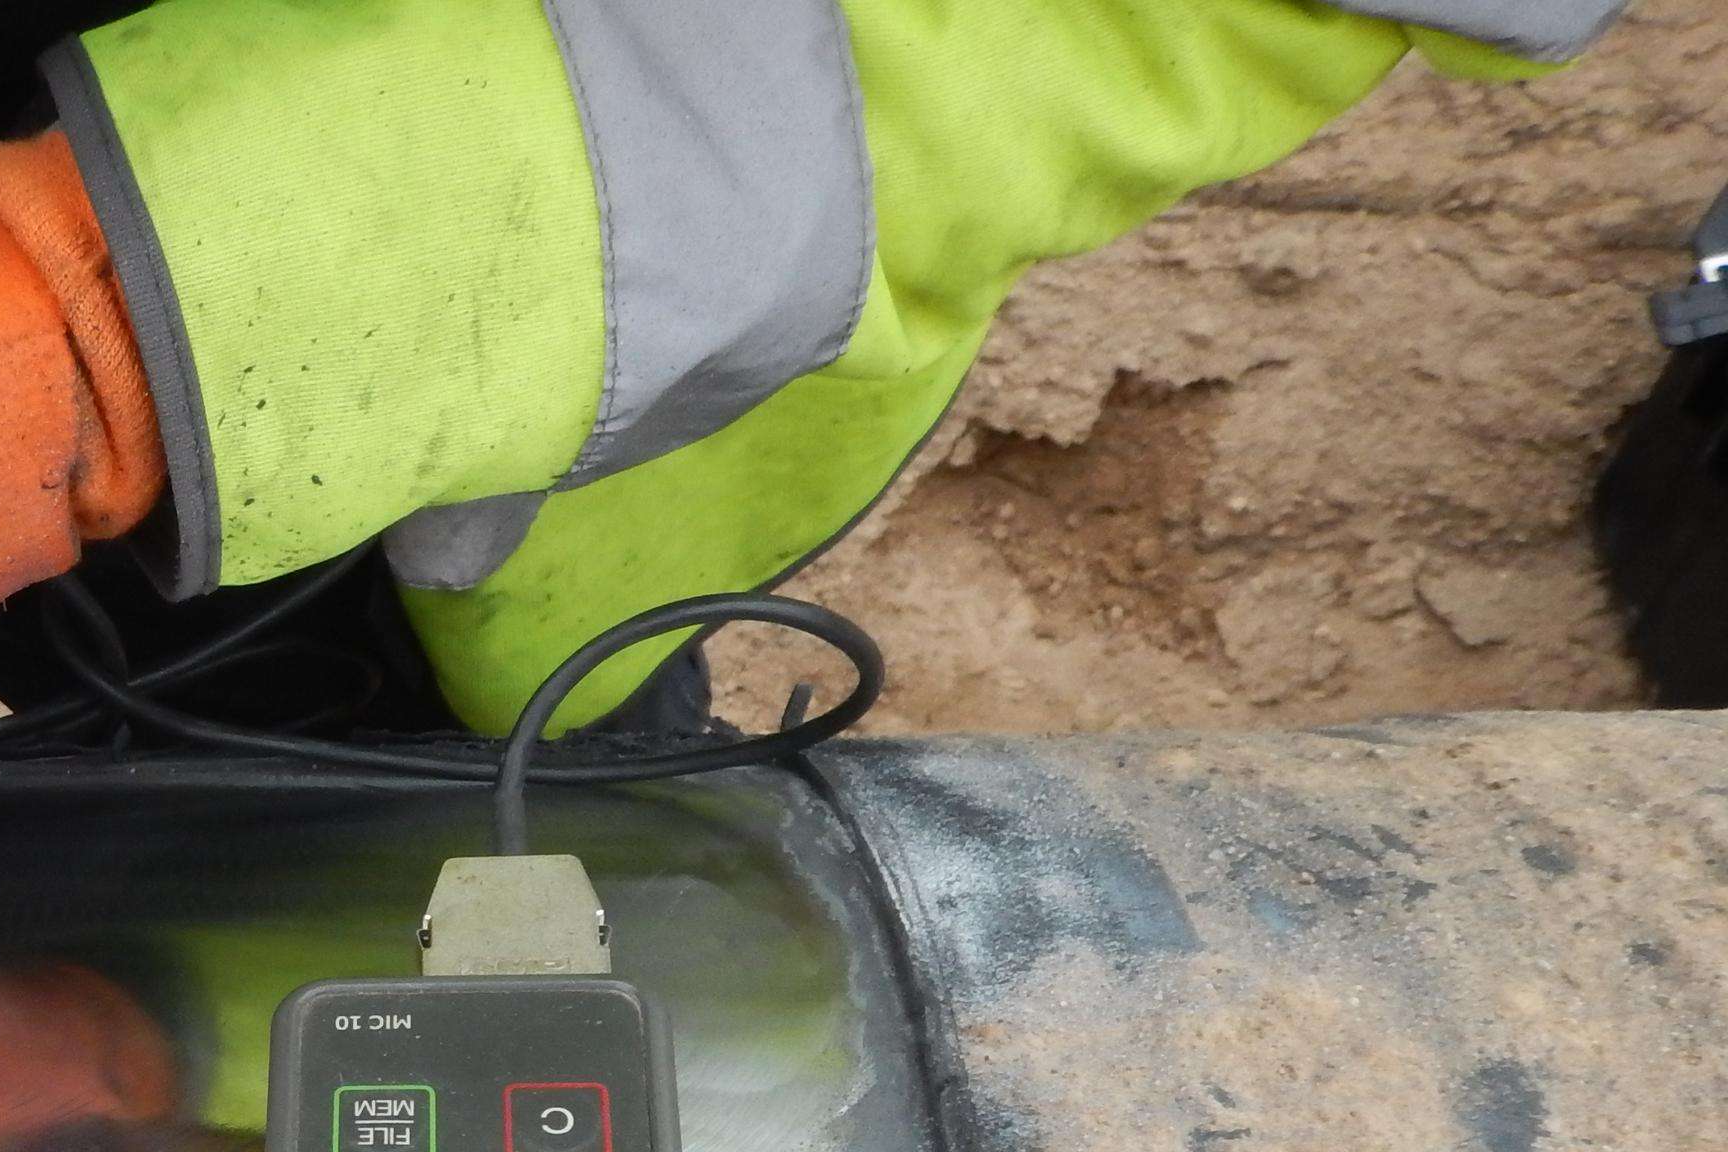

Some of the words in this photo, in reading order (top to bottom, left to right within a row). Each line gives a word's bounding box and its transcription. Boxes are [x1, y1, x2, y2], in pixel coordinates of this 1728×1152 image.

[335, 1014, 362, 1030] 10
[369, 1014, 412, 1030] MIC
[354, 1100, 414, 1117] MEM
[540, 1107, 574, 1135] C
[357, 1127, 411, 1145] FILE
